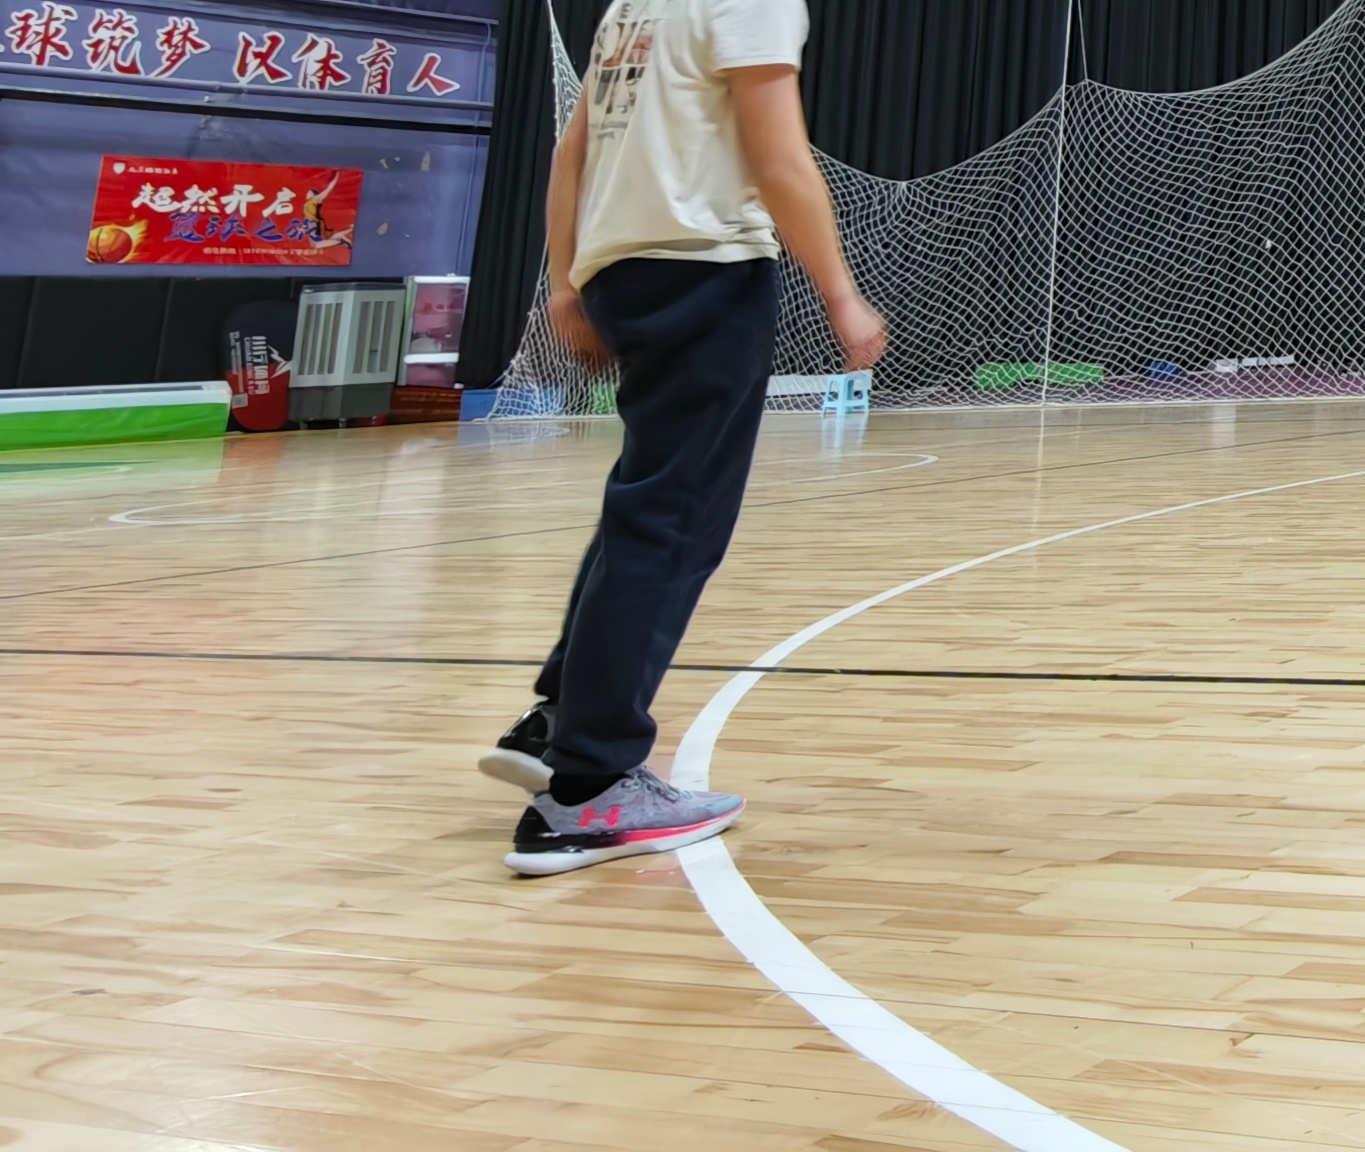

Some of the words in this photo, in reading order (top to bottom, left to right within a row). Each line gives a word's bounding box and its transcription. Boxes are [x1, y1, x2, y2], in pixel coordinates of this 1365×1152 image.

[1, 1, 211, 77] 球筑梦
[233, 31, 461, 96] 以体育人
[131, 182, 297, 217] 超然开启
